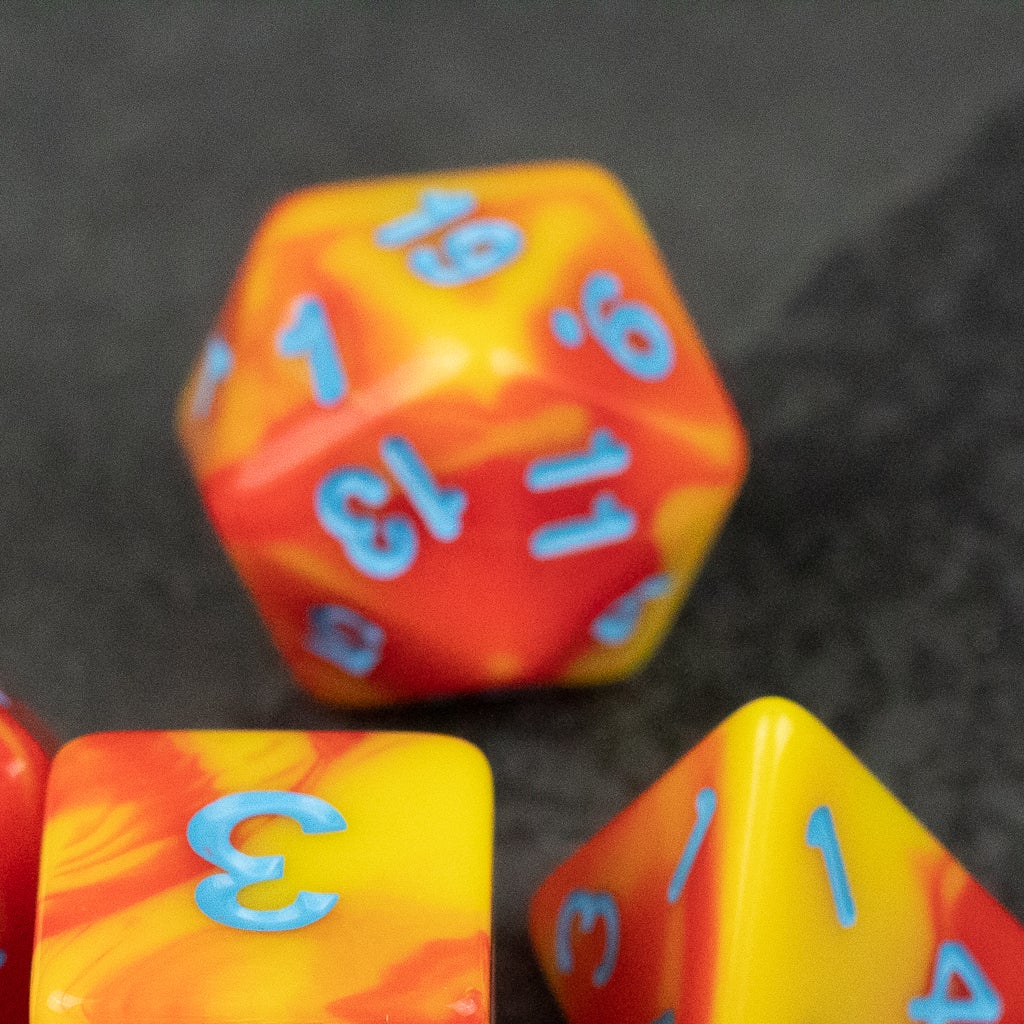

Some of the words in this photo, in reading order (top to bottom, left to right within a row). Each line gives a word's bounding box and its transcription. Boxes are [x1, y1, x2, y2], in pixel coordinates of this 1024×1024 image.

[374, 188, 526, 287] 19
[276, 297, 347, 407] 1
[315, 434, 468, 580] 13
[525, 427, 636, 560] 11
[186, 790, 348, 933] 3
[668, 786, 716, 904] 1
[806, 805, 856, 929] 1
[555, 889, 621, 987] 3
